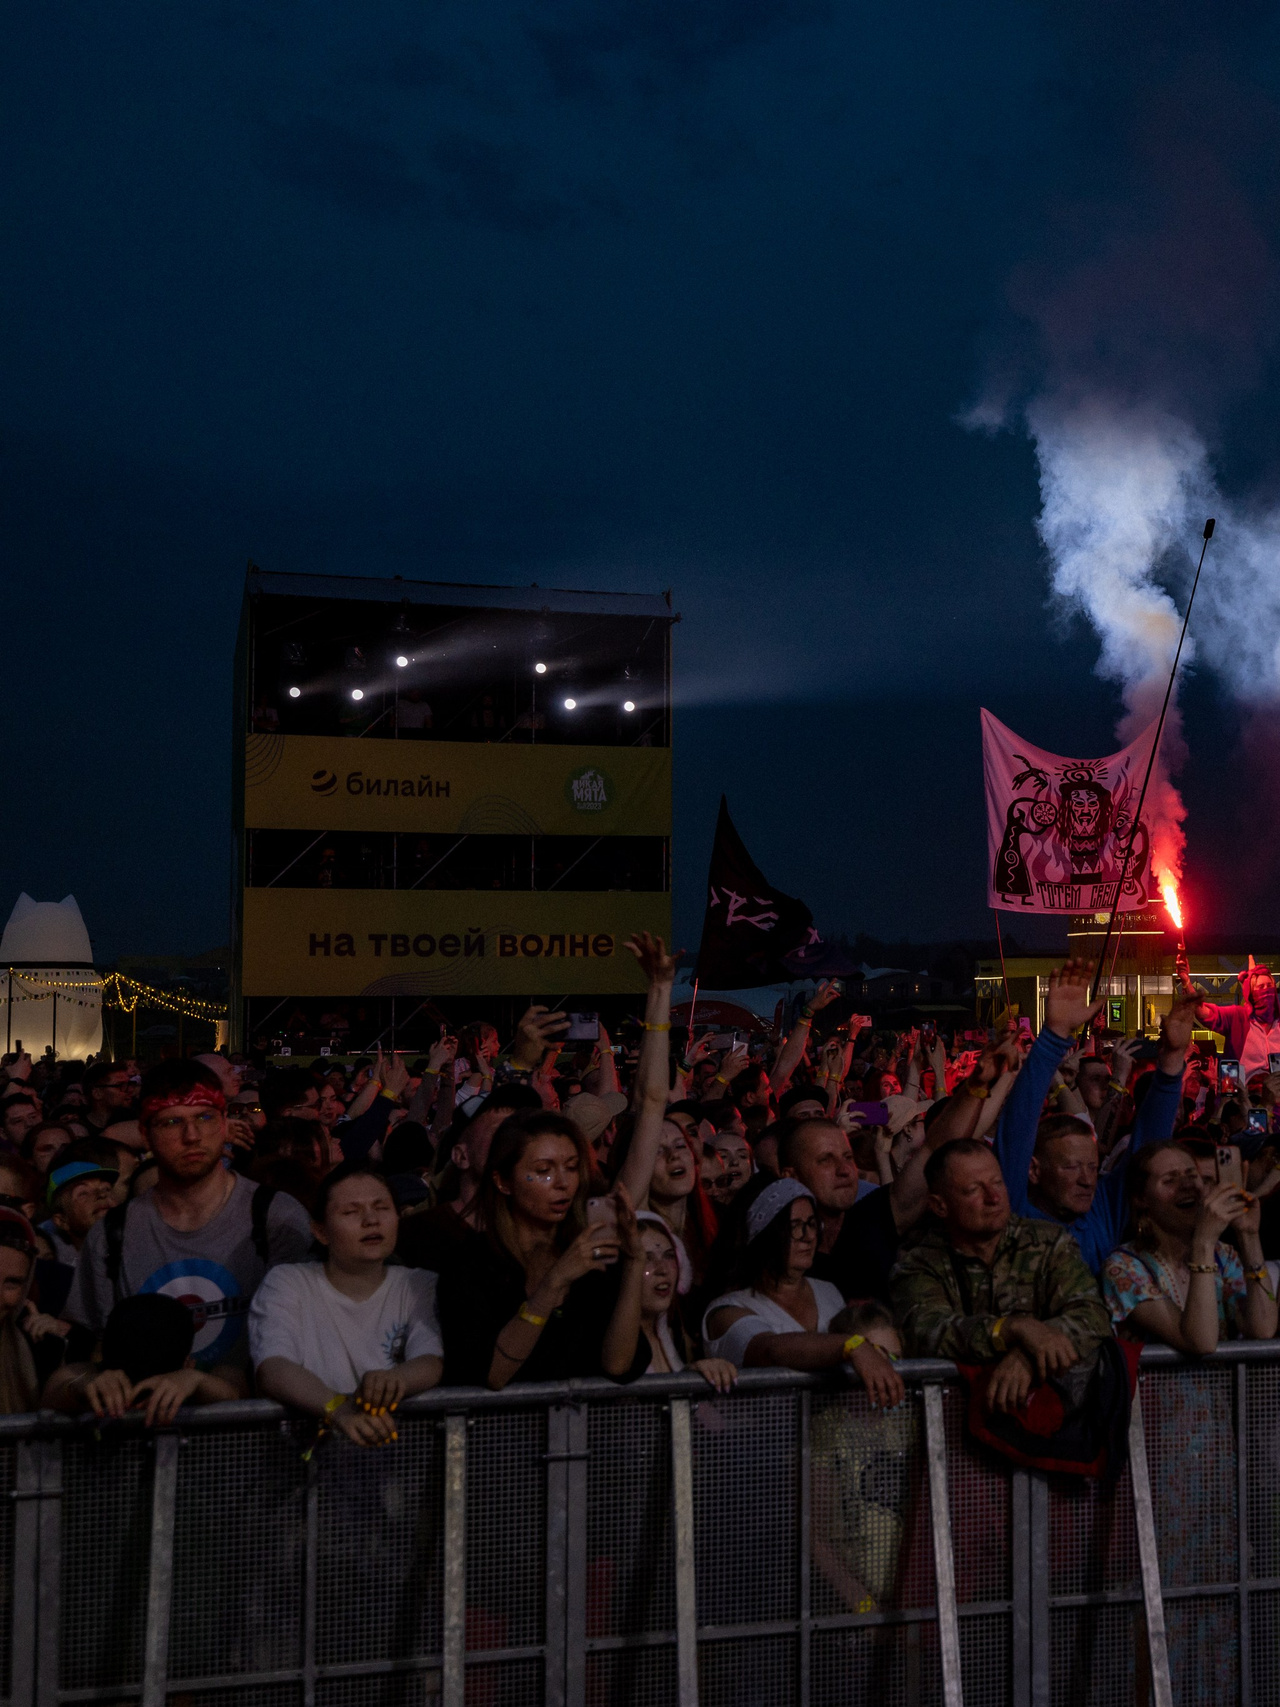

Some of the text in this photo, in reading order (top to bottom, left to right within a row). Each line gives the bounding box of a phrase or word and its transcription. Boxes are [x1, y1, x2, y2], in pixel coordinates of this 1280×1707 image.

[346, 771, 450, 798] билайн
[573, 789, 607, 801] МЯТА
[1036, 883, 1081, 908] TOTEM
[309, 927, 614, 957] на твоей волне
